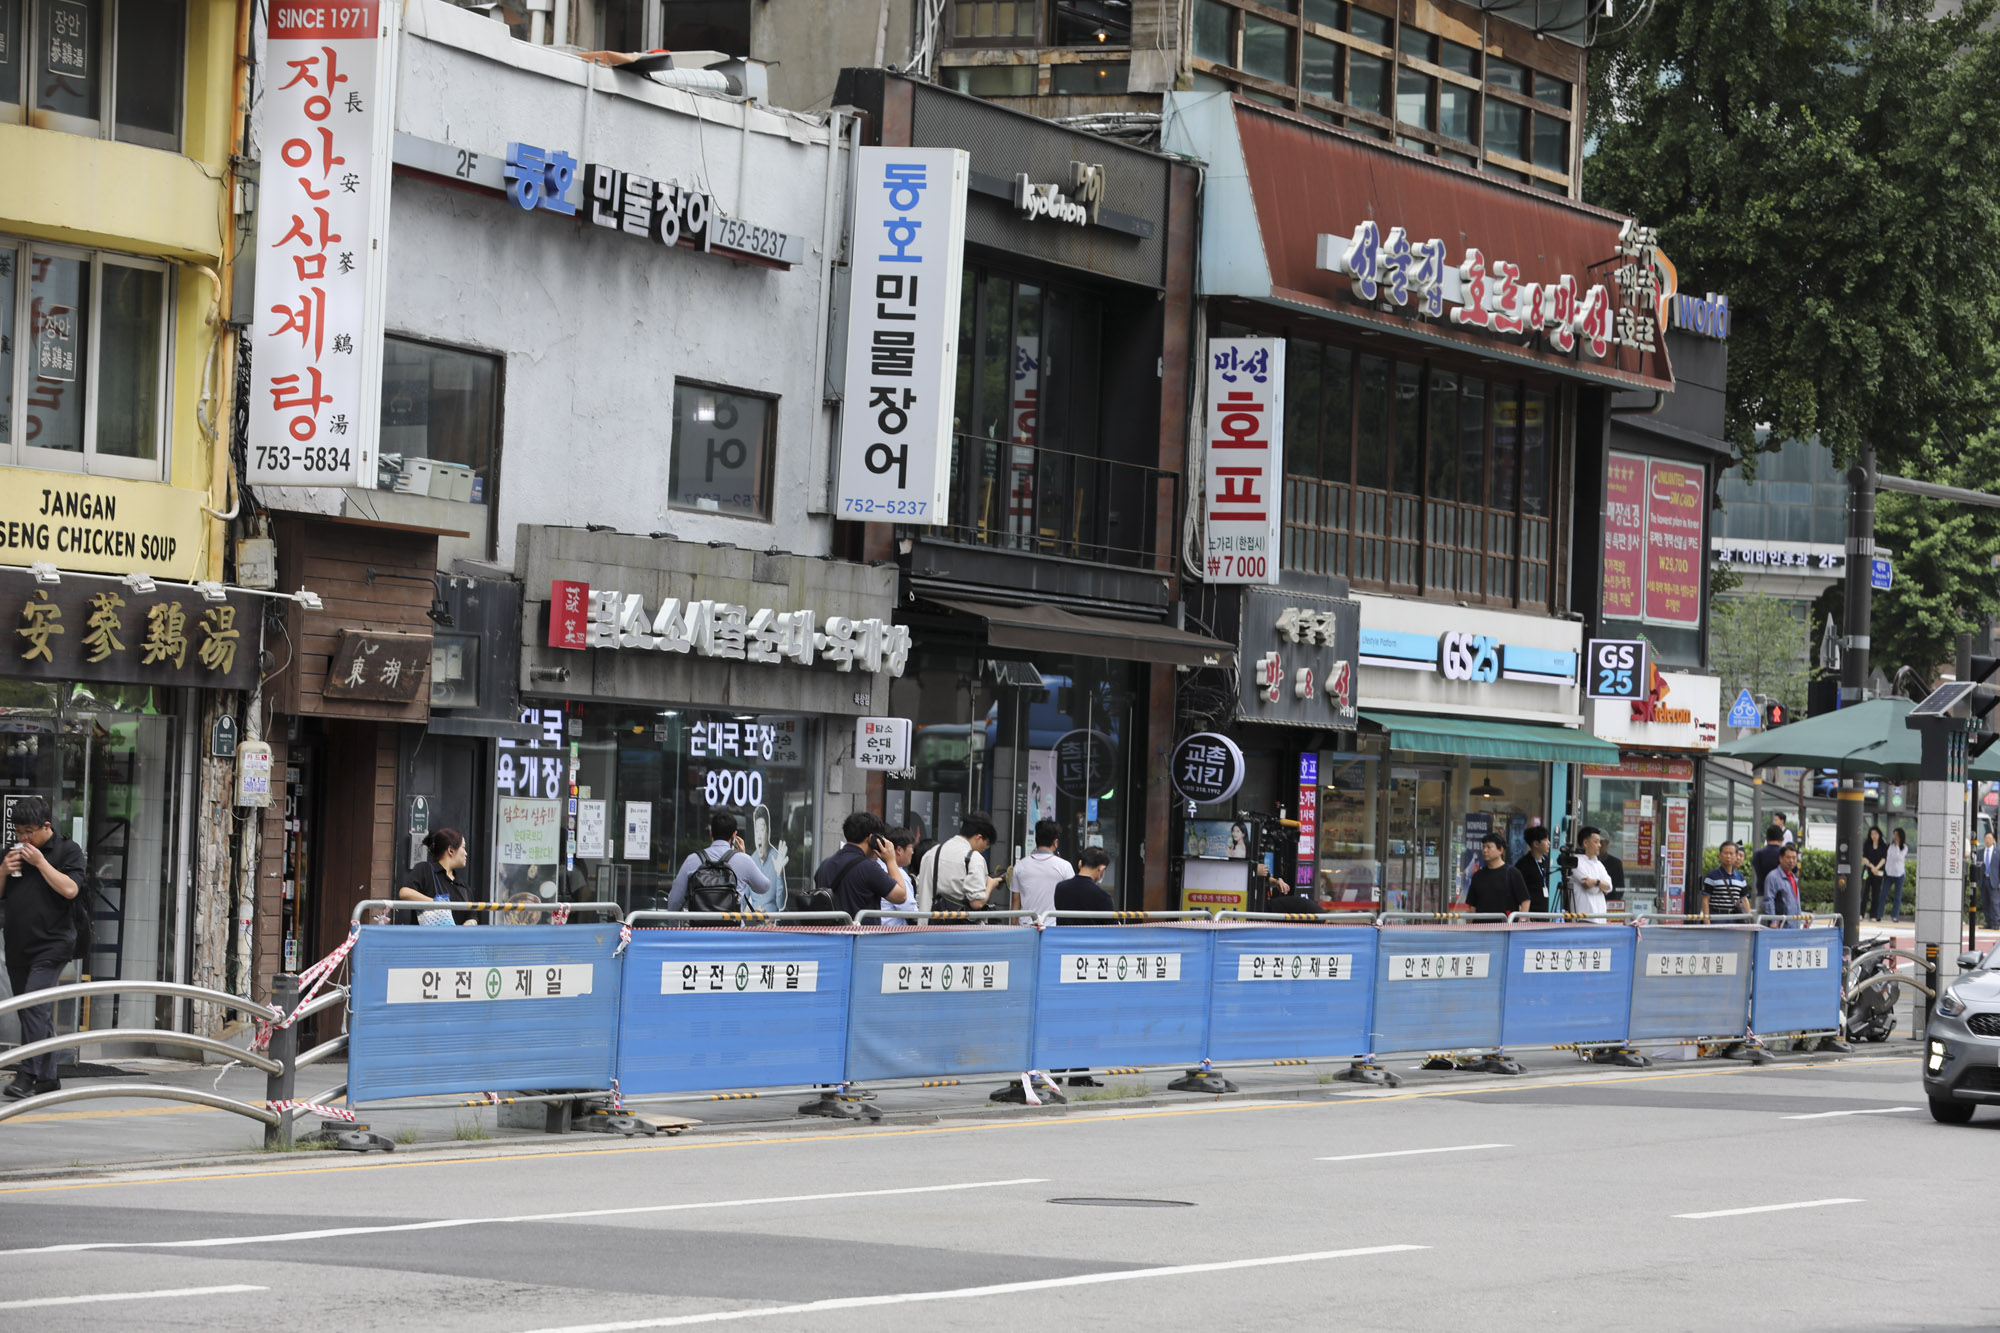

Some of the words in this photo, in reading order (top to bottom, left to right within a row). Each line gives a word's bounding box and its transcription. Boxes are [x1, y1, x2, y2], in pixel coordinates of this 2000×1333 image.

[55, 10, 81, 37] 장안
[277, 8, 325, 29] SINCE
[330, 8, 370, 29] 1971
[456, 149, 478, 180] 2F
[504, 142, 578, 216] 동호
[583, 163, 714, 253] 민물장어
[719, 218, 788, 259] 752-5237
[878, 163, 928, 263] 동호
[268, 46, 349, 441] 장안삼계탕
[1615, 219, 1658, 265] 소주
[1342, 220, 1447, 319] 선술집
[45, 315, 71, 341] 장안
[1675, 292, 1729, 339] world
[1214, 346, 1269, 384] 만선
[864, 274, 918, 490] 민물장어
[256, 446, 350, 472] 753-5834
[1210, 392, 1268, 521] 호프
[40, 489, 116, 521] JANGAN
[844, 498, 928, 516] 752-5237
[57, 526, 135, 558] CHICKEN
[140, 534, 177, 562] SOUP
[1208, 536, 1233, 551] 노가리
[1235, 535, 1266, 552] (한접시)
[1742, 549, 1808, 567] 이비인후과
[1819, 553, 1837, 569] 2F
[1440, 631, 1499, 684] GS25
[1599, 645, 1634, 669] GS
[1598, 669, 1633, 695] 25
[1654, 701, 1691, 723] telecom
[691, 721, 739, 758] 순대국
[744, 722, 777, 761] 포장
[867, 737, 891, 749] 순대
[1185, 743, 1227, 765] 교촌
[860, 753, 897, 765] 육개장
[497, 753, 563, 800] 육개장
[705, 770, 762, 806] 8900
[1183, 764, 1225, 787] 치킨
[504, 804, 529, 824] 담소의
[1076, 957, 1109, 980] 안전
[1136, 956, 1168, 979] 제일
[1253, 956, 1284, 979] 안전
[1309, 955, 1340, 977] 제일
[1405, 957, 1430, 979] 안전
[1450, 956, 1475, 976] 제일
[1535, 950, 1560, 970] 안전
[1578, 950, 1601, 969] 제일
[1660, 957, 1684, 975] 안전
[1701, 955, 1724, 974] 제일
[1776, 950, 1793, 968] 안전
[1805, 950, 1822, 968] 제일
[422, 970, 473, 999] 안전
[516, 967, 564, 996] 제일
[682, 963, 725, 991] 안전
[760, 963, 800, 990] 제일
[898, 964, 934, 991] 안전
[961, 962, 995, 988] 제일
